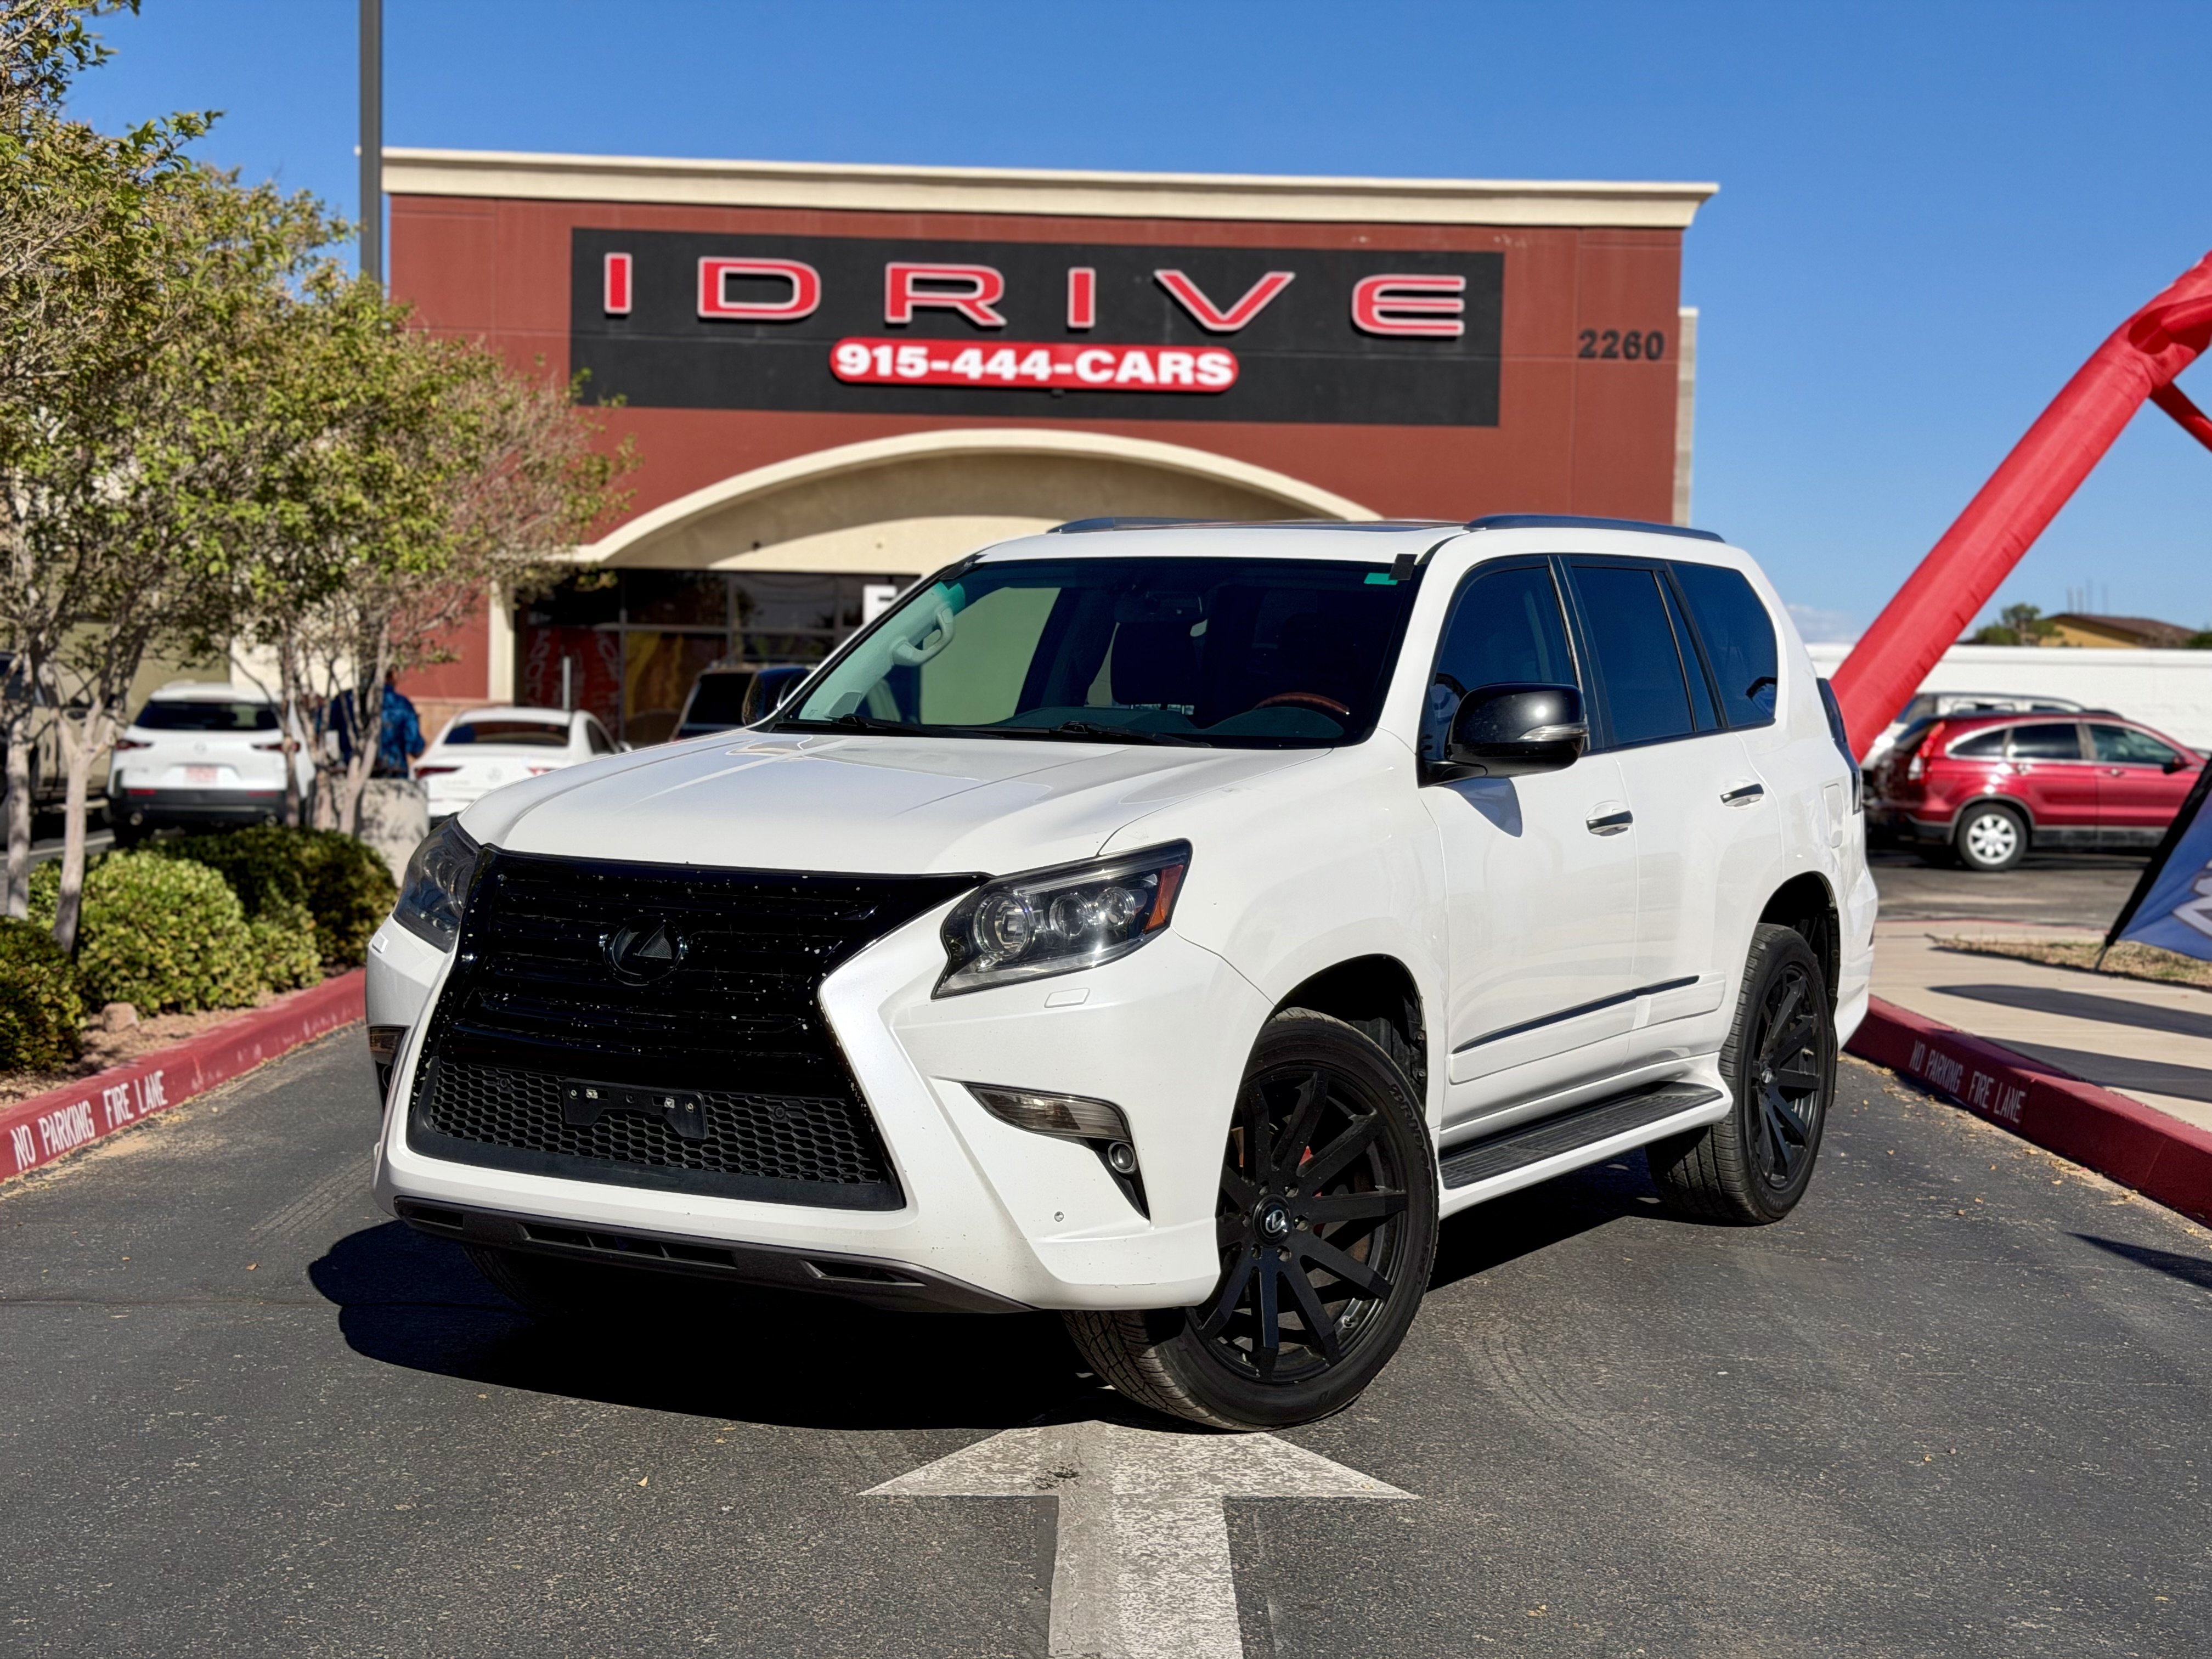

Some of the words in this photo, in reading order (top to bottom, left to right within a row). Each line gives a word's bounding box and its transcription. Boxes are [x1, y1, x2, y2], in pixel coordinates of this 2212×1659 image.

[604, 252, 1465, 336] IDRIVE
[836, 343, 1234, 386] 915-444-CARS
[1578, 329, 1664, 361] 2260
[10, 1124, 36, 1171] NO
[38, 1100, 95, 1156] PARKING
[103, 1082, 134, 1129] FIRE
[134, 1070, 168, 1114] LANE
[1909, 1040, 1926, 1072] NO
[1925, 1049, 1963, 1093] PARKING
[1968, 1070, 1995, 1109] FIRE
[1994, 1081, 2026, 1124] LANE
